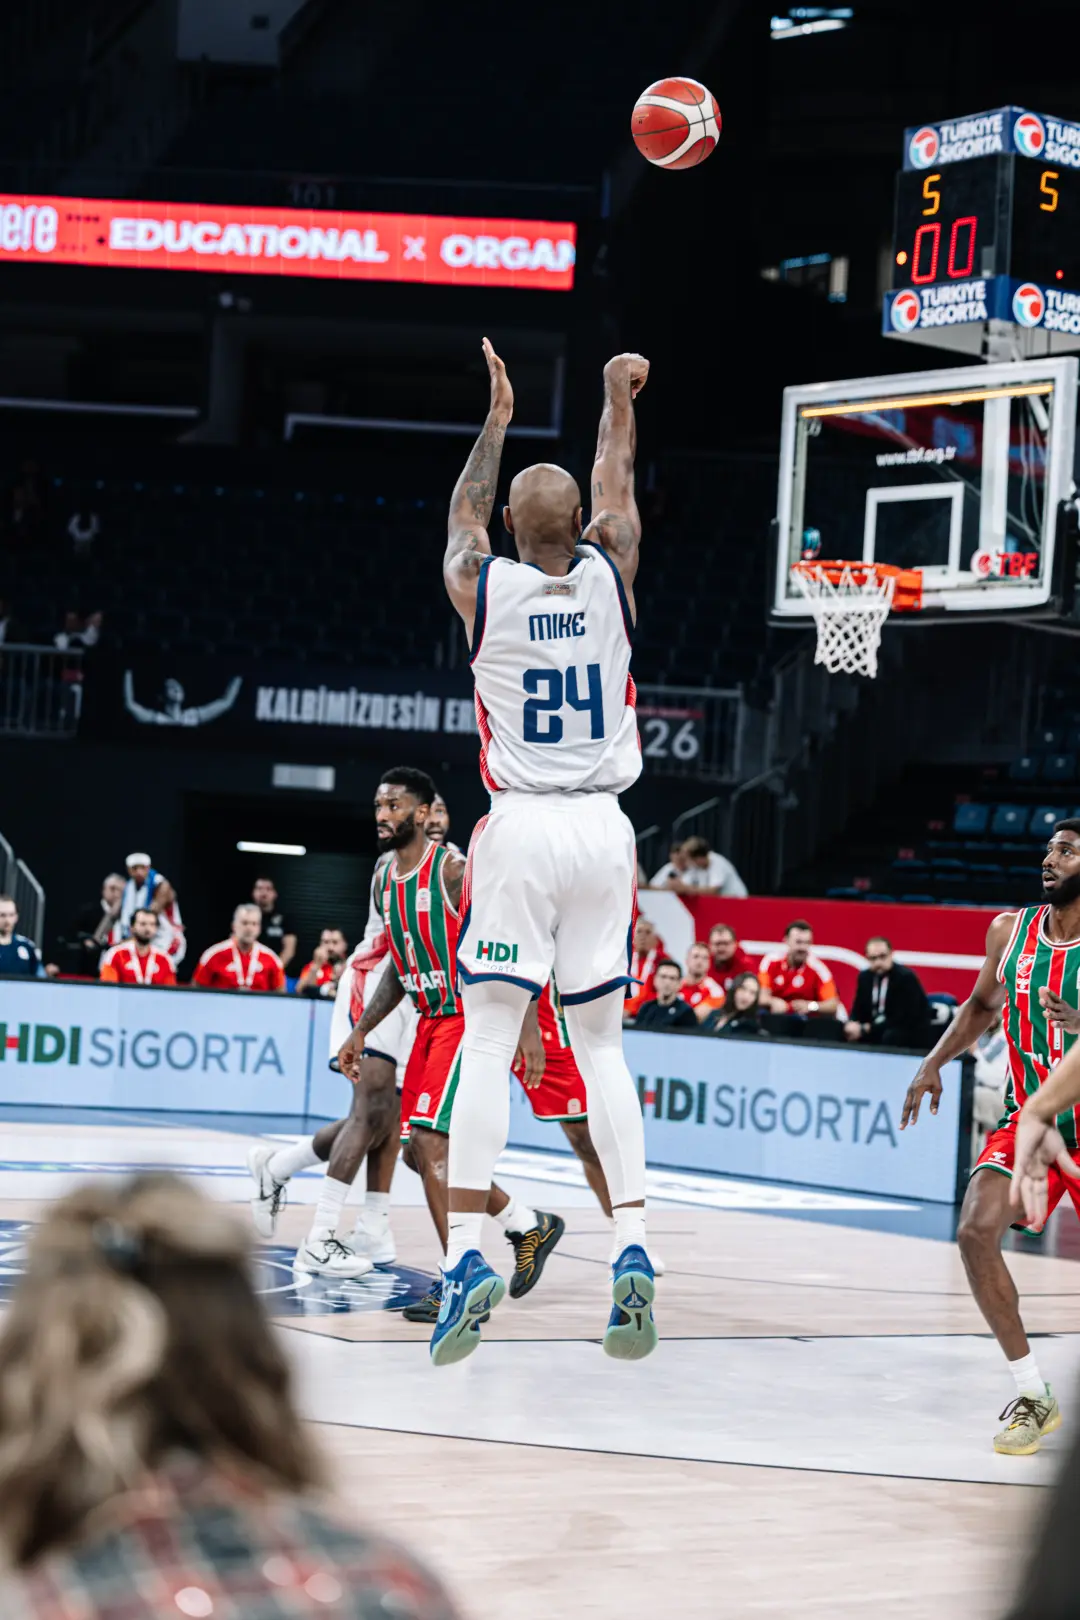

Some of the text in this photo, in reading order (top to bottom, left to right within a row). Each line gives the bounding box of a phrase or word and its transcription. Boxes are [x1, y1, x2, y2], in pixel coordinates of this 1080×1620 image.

[922, 174, 941, 216] 5
[1040, 171, 1059, 212] 5
[0, 204, 58, 252] ere
[109, 217, 389, 263] EDUCATIONAL
[911, 216, 978, 285] 00
[997, 552, 1039, 577] TBF
[528, 612, 586, 641] MIKE
[522, 663, 605, 743] 24
[476, 940, 518, 963] HDI
[0, 1022, 81, 1066] HDI
[637, 1074, 708, 1125] HDI
